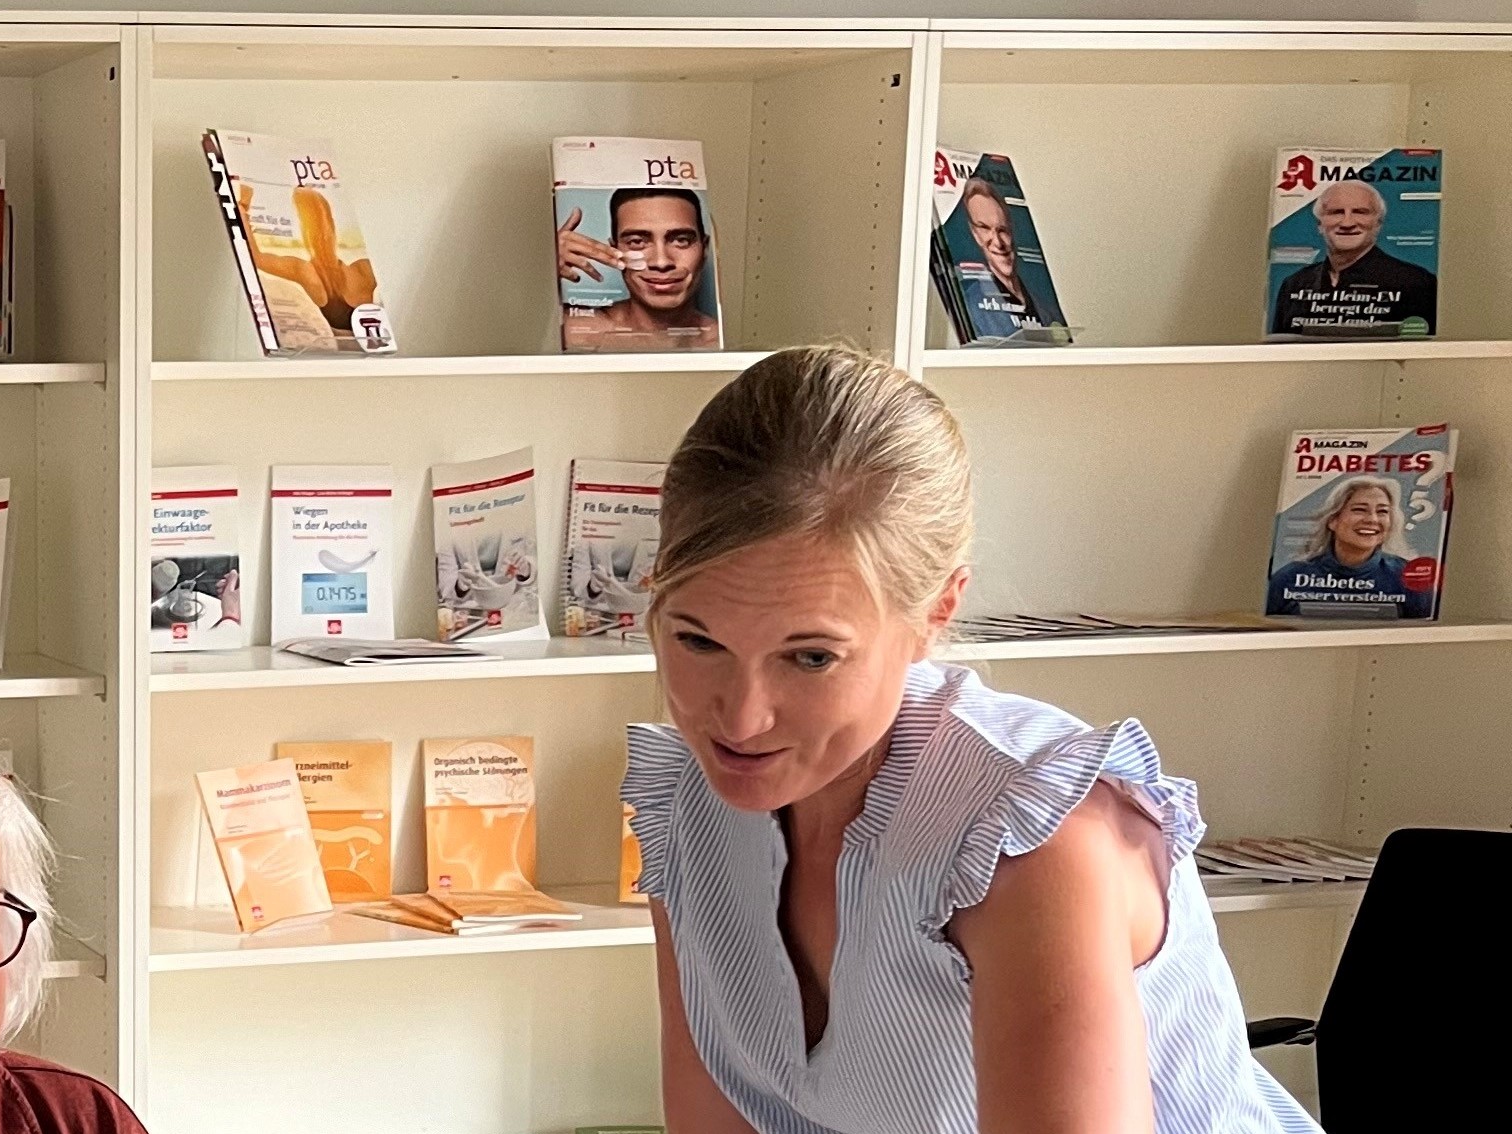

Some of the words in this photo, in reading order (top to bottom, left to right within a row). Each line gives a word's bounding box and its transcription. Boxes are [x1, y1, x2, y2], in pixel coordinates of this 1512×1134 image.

[290, 156, 338, 187] pta
[644, 156, 698, 185] pta
[1320, 165, 1437, 182] MAGAZIN
[1296, 454, 1432, 473] DIABETES
[323, 520, 367, 531] Apotheke
[1295, 573, 1375, 589] Diabetes
[1283, 588, 1332, 602] besser
[1333, 591, 1406, 603] verstehen
